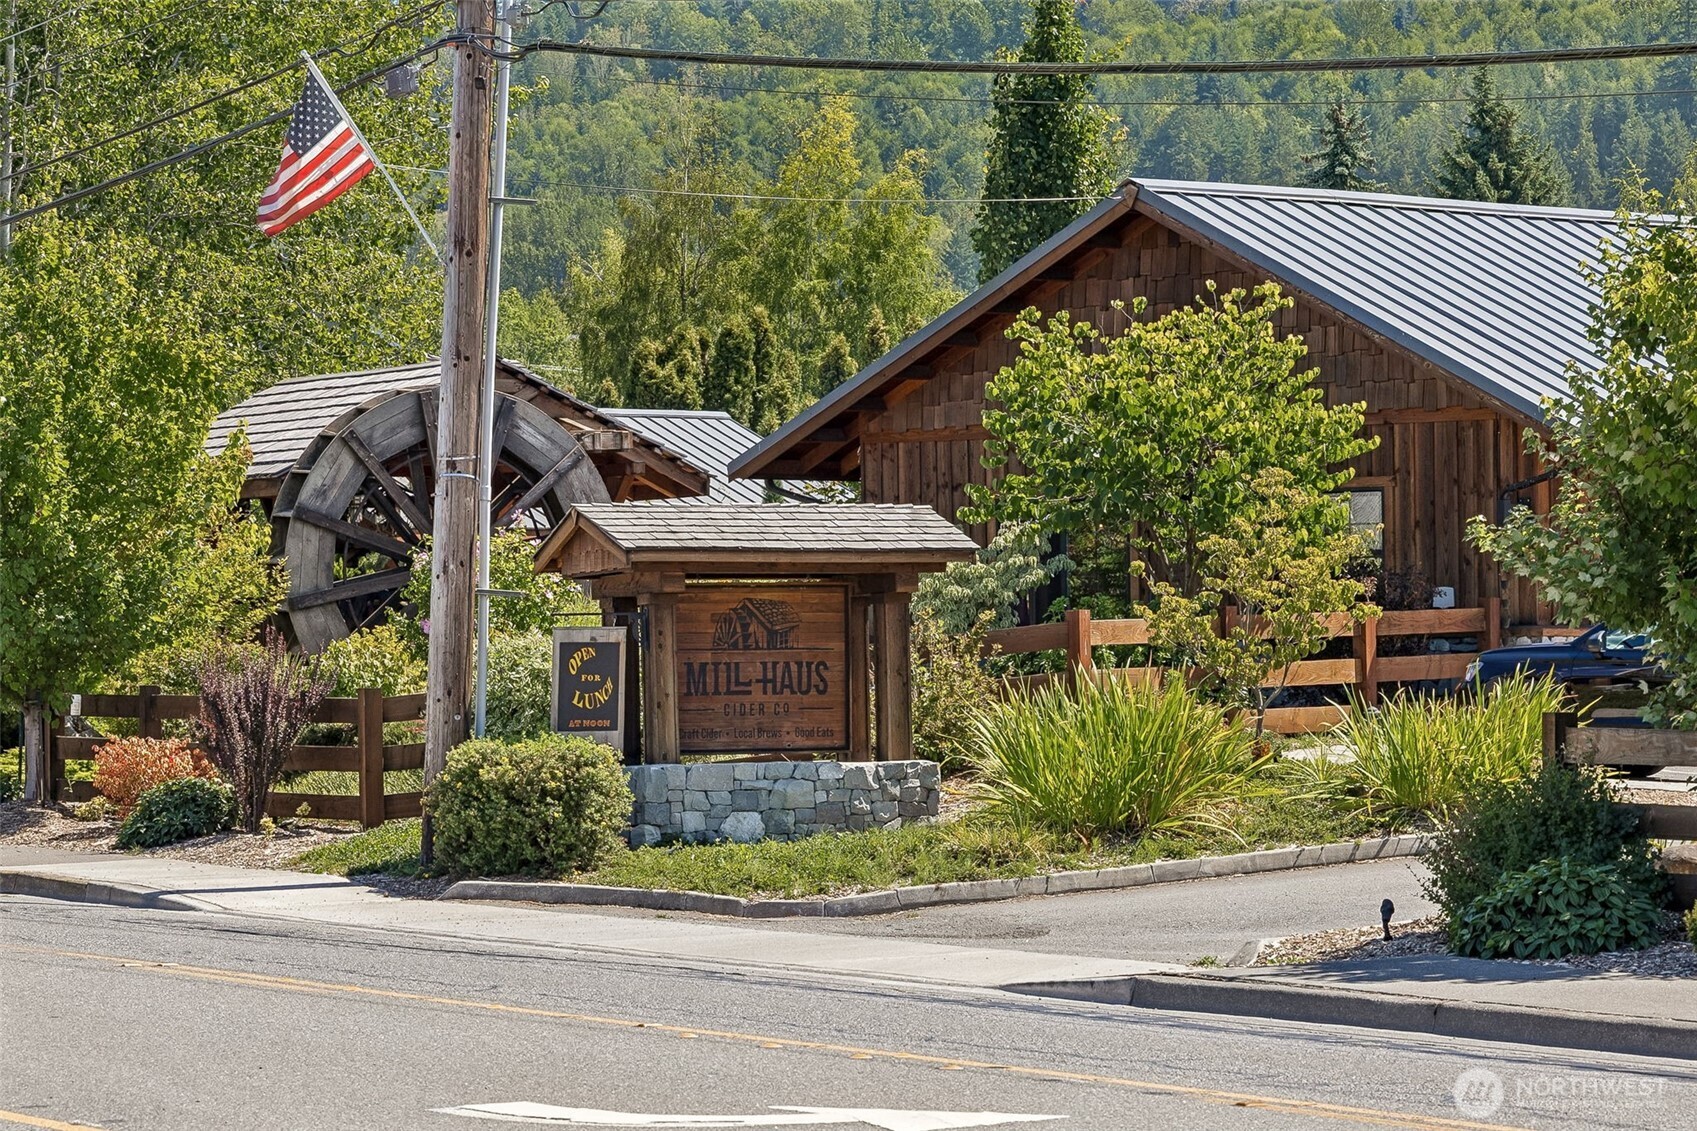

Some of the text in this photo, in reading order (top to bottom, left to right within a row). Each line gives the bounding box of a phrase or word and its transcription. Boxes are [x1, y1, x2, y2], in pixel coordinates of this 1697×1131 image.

[568, 647, 596, 675] OPEN
[572, 677, 613, 709] LUNCH
[723, 703, 766, 717] CIDER
[701, 727, 723, 740] Cider
[733, 727, 756, 740] Local
[757, 727, 783, 739] Brews
[794, 726, 816, 738] Good
[816, 726, 835, 738] Eats
